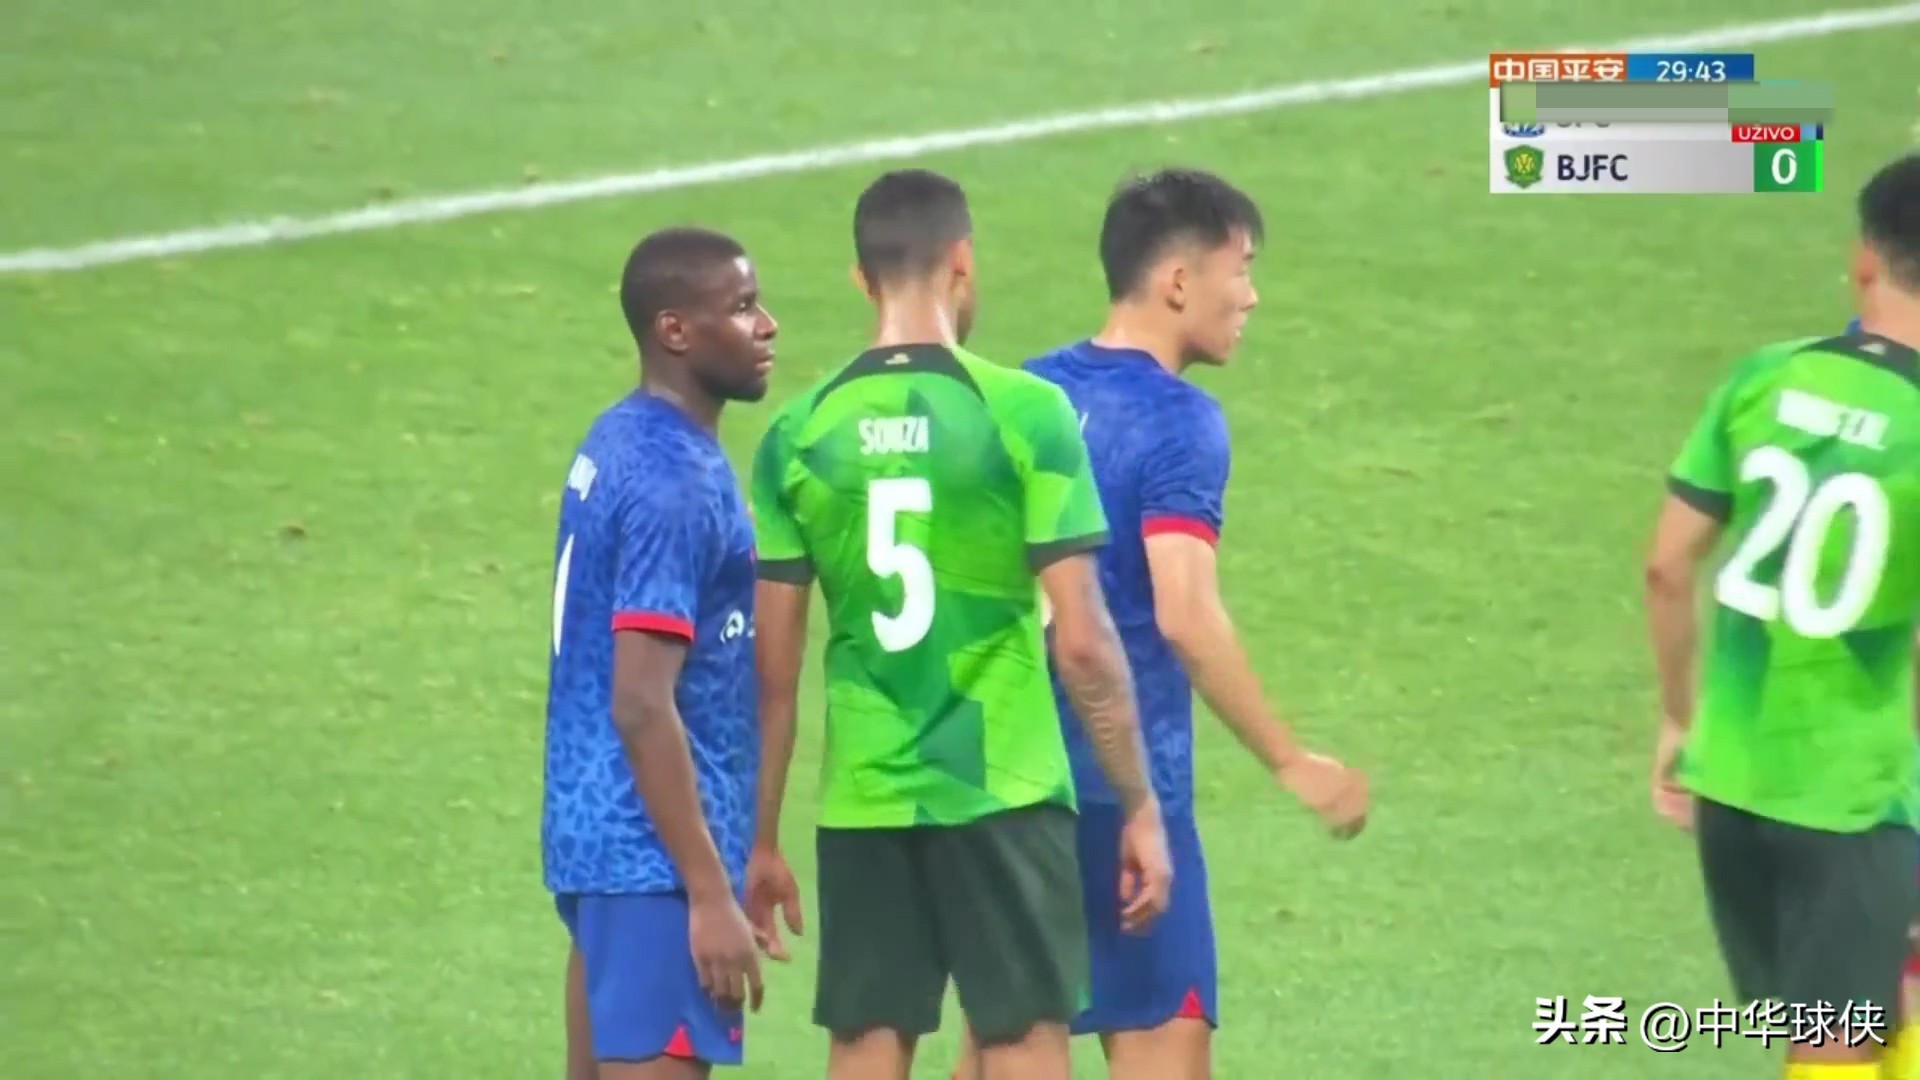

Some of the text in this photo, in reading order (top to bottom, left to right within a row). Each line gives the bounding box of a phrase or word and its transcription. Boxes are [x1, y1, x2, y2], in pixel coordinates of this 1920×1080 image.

[858, 416, 930, 455] SOUZA
[866, 477, 936, 652] 5
[1714, 445, 1891, 639] 20
